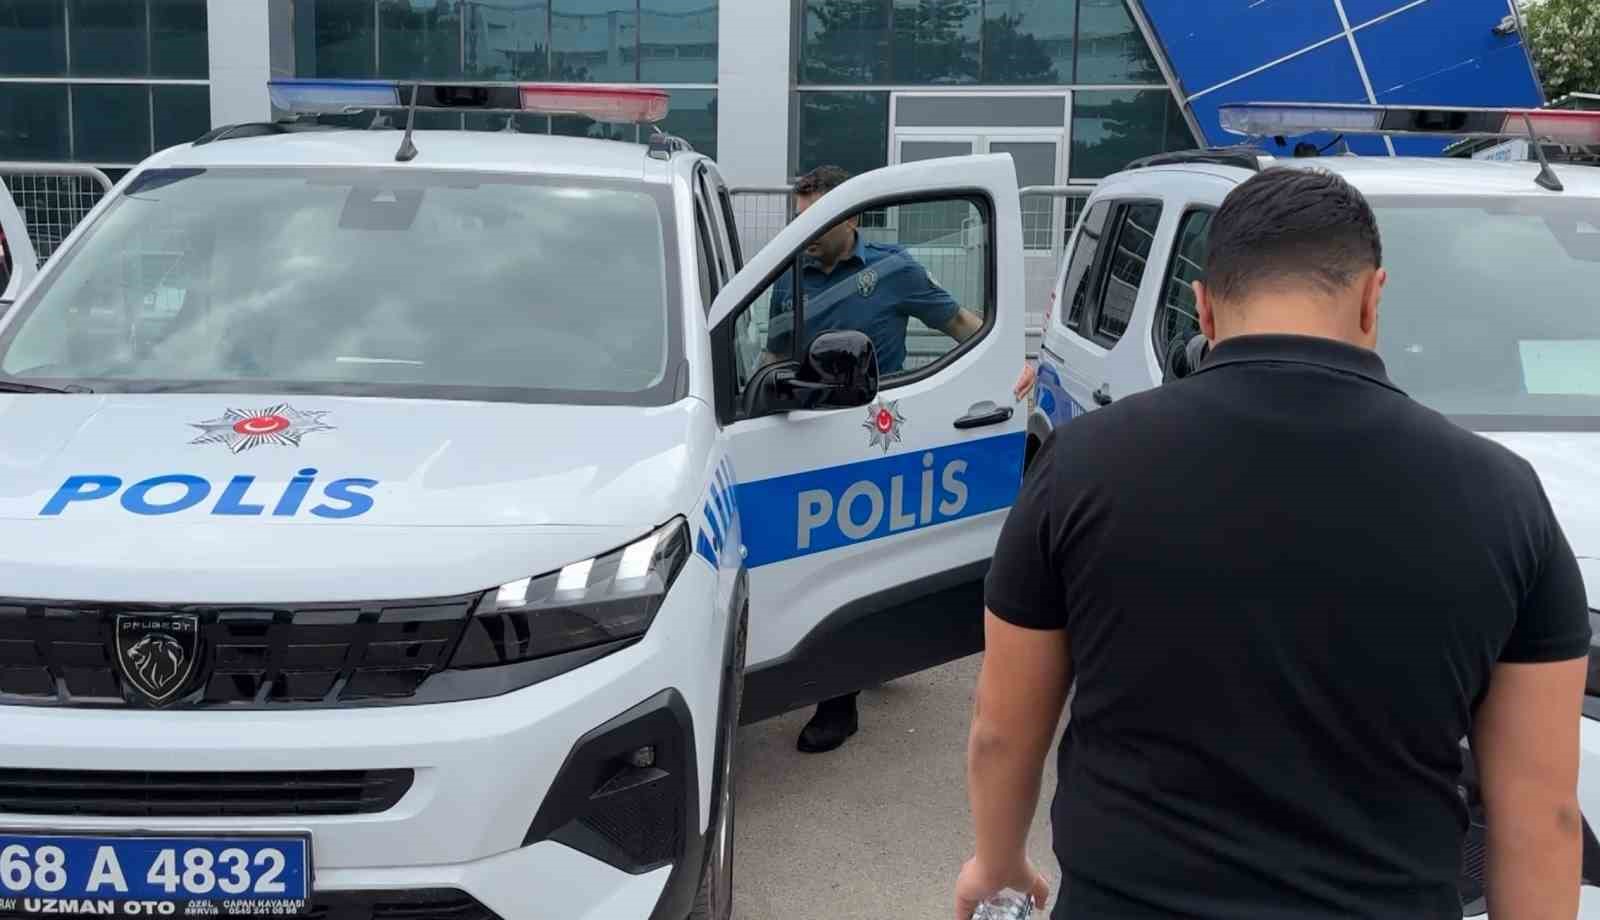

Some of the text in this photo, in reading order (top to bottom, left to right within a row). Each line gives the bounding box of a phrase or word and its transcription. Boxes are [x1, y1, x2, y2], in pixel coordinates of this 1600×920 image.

[39, 467, 378, 519] POLİS
[796, 451, 970, 550] POLİS
[122, 622, 191, 631] PEUGEOT
[0, 844, 286, 894] 68 A 4832
[24, 898, 113, 915] UZMAN
[123, 900, 176, 915] OTO
